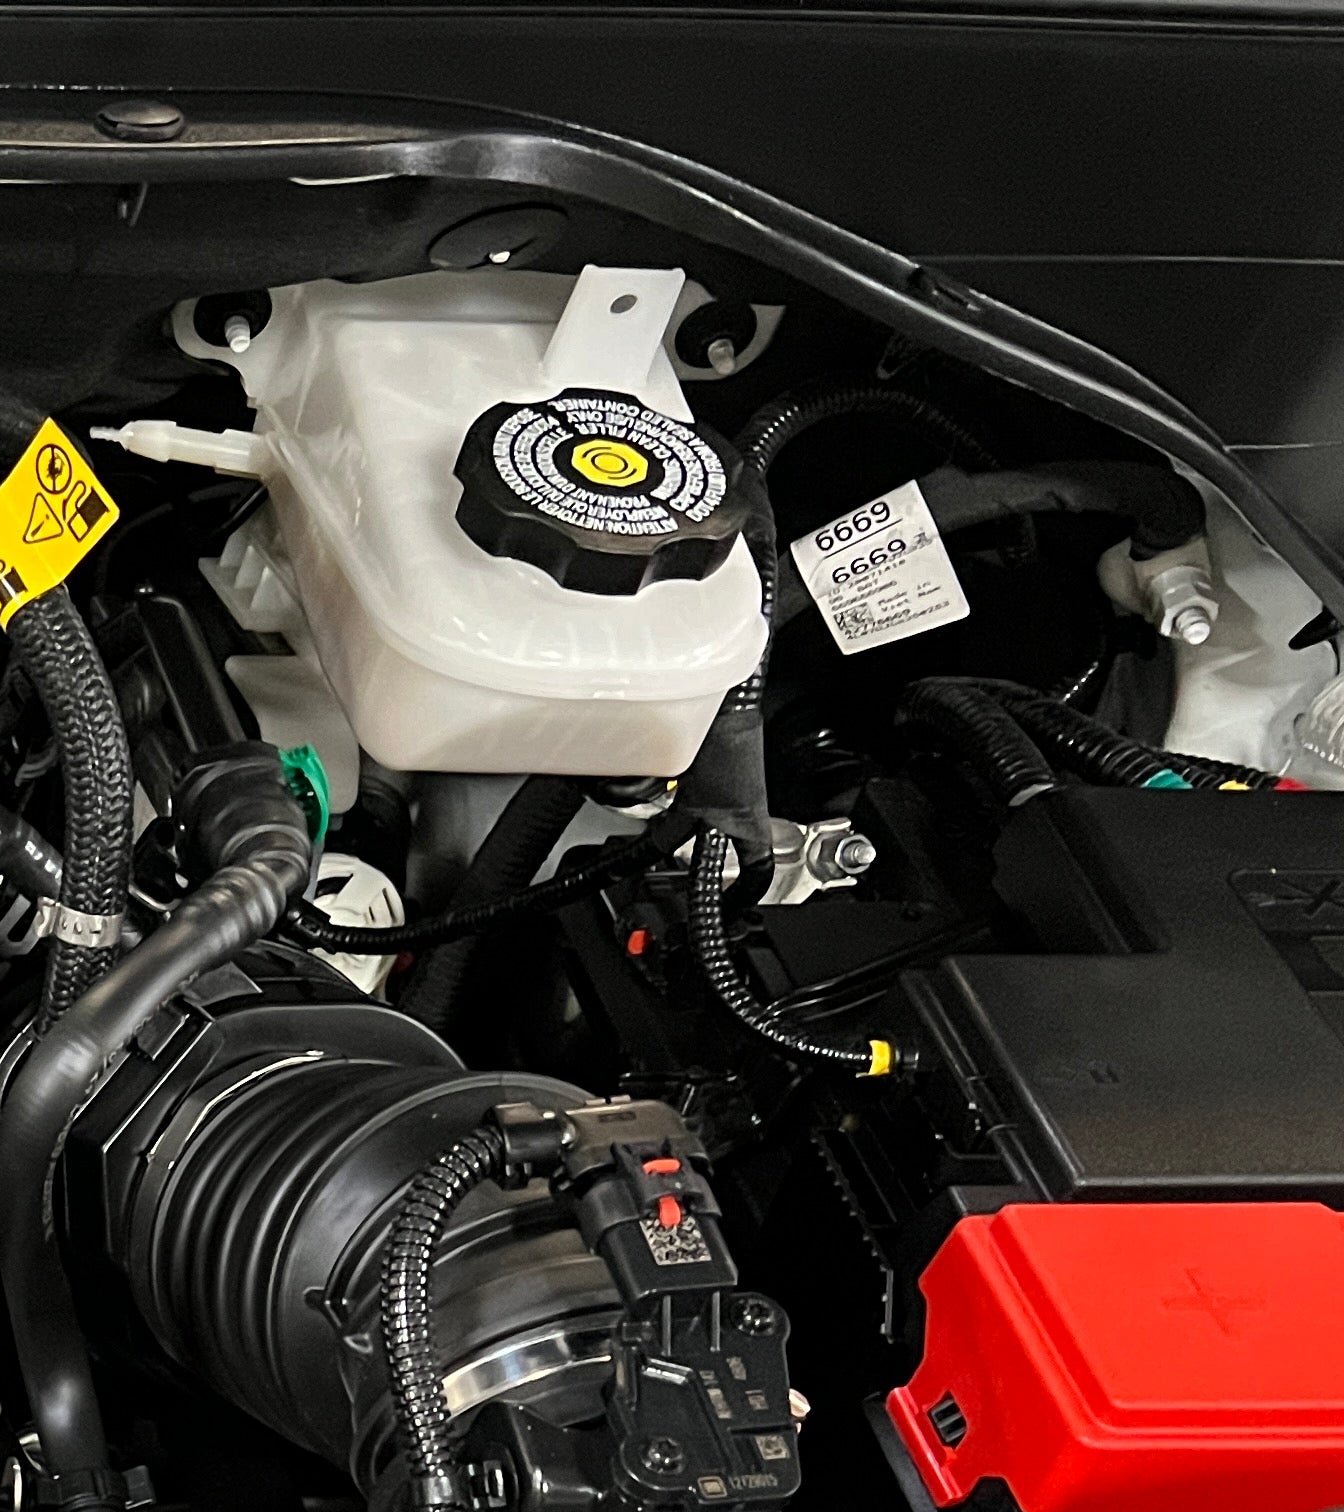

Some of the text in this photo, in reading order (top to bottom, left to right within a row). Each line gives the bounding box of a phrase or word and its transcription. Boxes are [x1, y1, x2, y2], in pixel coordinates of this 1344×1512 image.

[534, 499, 604, 532] NETTOYER
[815, 500, 891, 551] 6669
[831, 538, 907, 584] 6669
